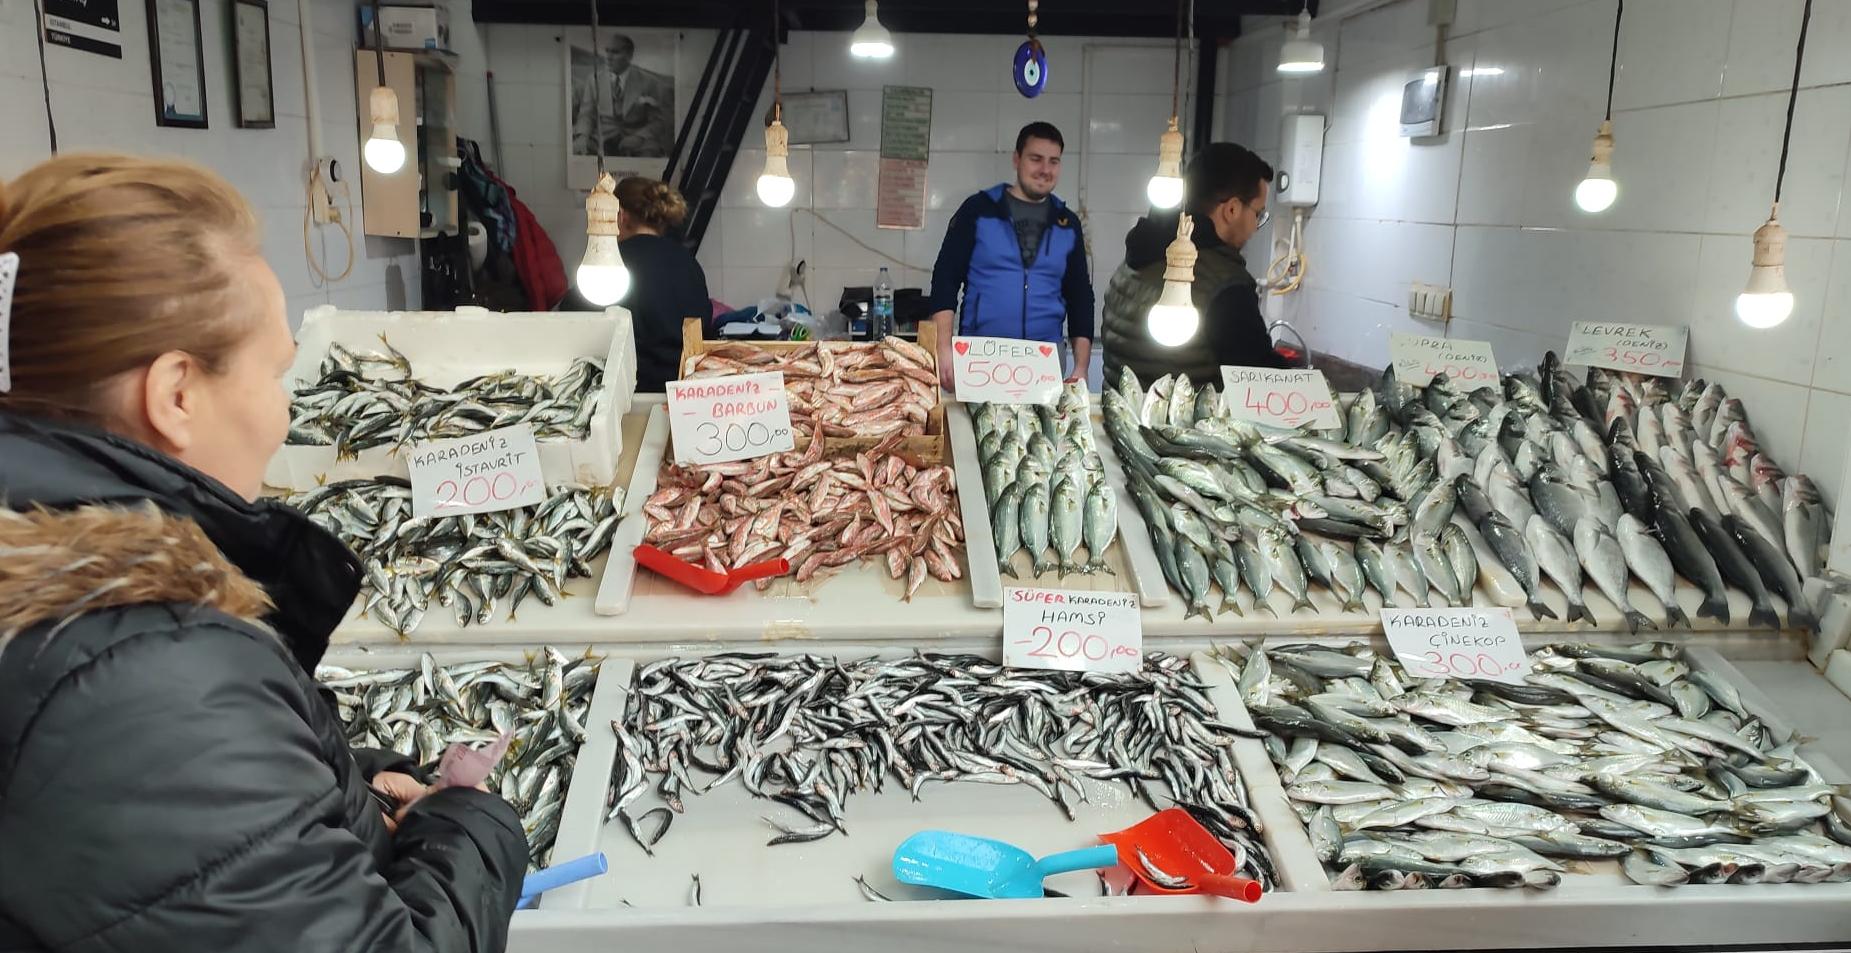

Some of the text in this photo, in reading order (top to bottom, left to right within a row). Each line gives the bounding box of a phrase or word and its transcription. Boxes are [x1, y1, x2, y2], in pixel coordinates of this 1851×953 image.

[1583, 326, 1652, 339] LEVREK
[969, 340, 1039, 358] LÜFER
[962, 361, 1056, 388] 500,00
[1231, 369, 1314, 384] SARIKANAT
[675, 380, 761, 400] KARADENİZ
[712, 400, 778, 418] BARBUN
[696, 422, 788, 456] 300,00
[413, 435, 508, 468] KARADENİZ
[1014, 589, 1137, 609] SÜPER KARADENİZ
[1389, 614, 1489, 628] KARADENİZ
[1429, 632, 1506, 648] ÇİNEKOP
